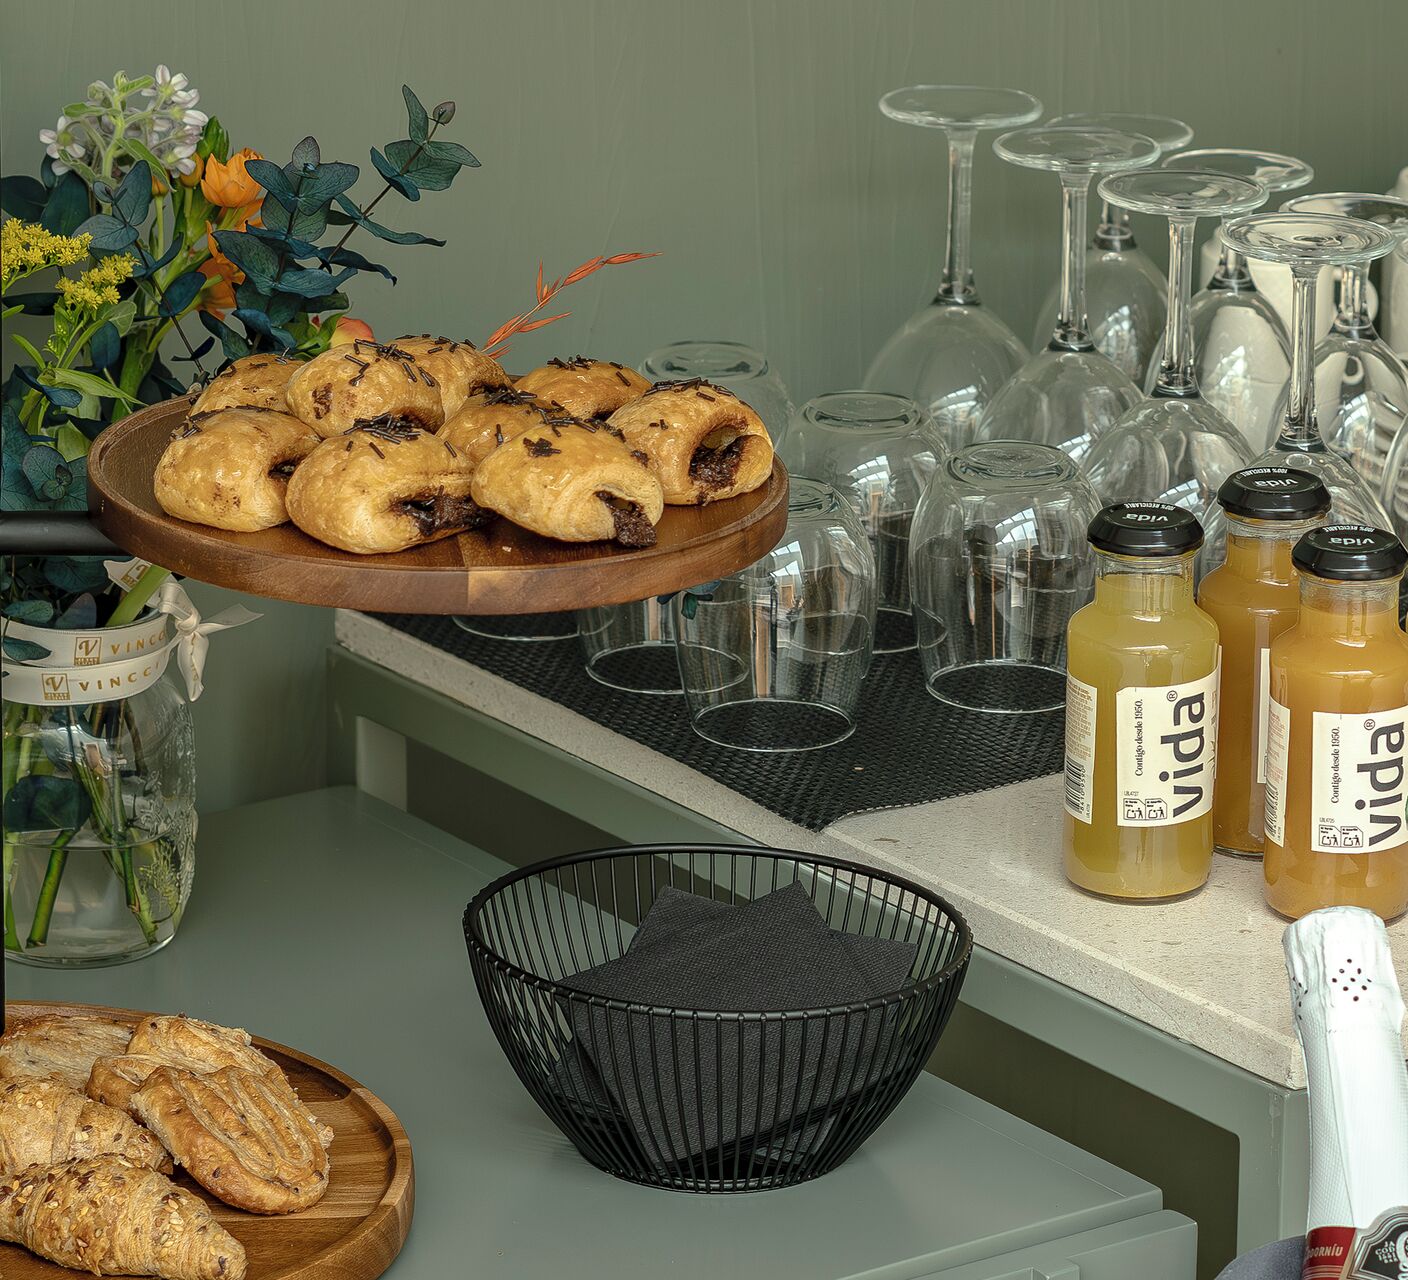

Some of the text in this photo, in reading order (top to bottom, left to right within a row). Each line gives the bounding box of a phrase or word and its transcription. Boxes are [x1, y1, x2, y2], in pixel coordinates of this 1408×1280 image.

[111, 630, 165, 655] VINCC
[79, 662, 159, 692] VINCCI
[1134, 721, 1143, 744] desde
[1134, 744, 1145, 776] Contigo
[1331, 748, 1340, 772] desde
[1331, 772, 1342, 803] Contigo
